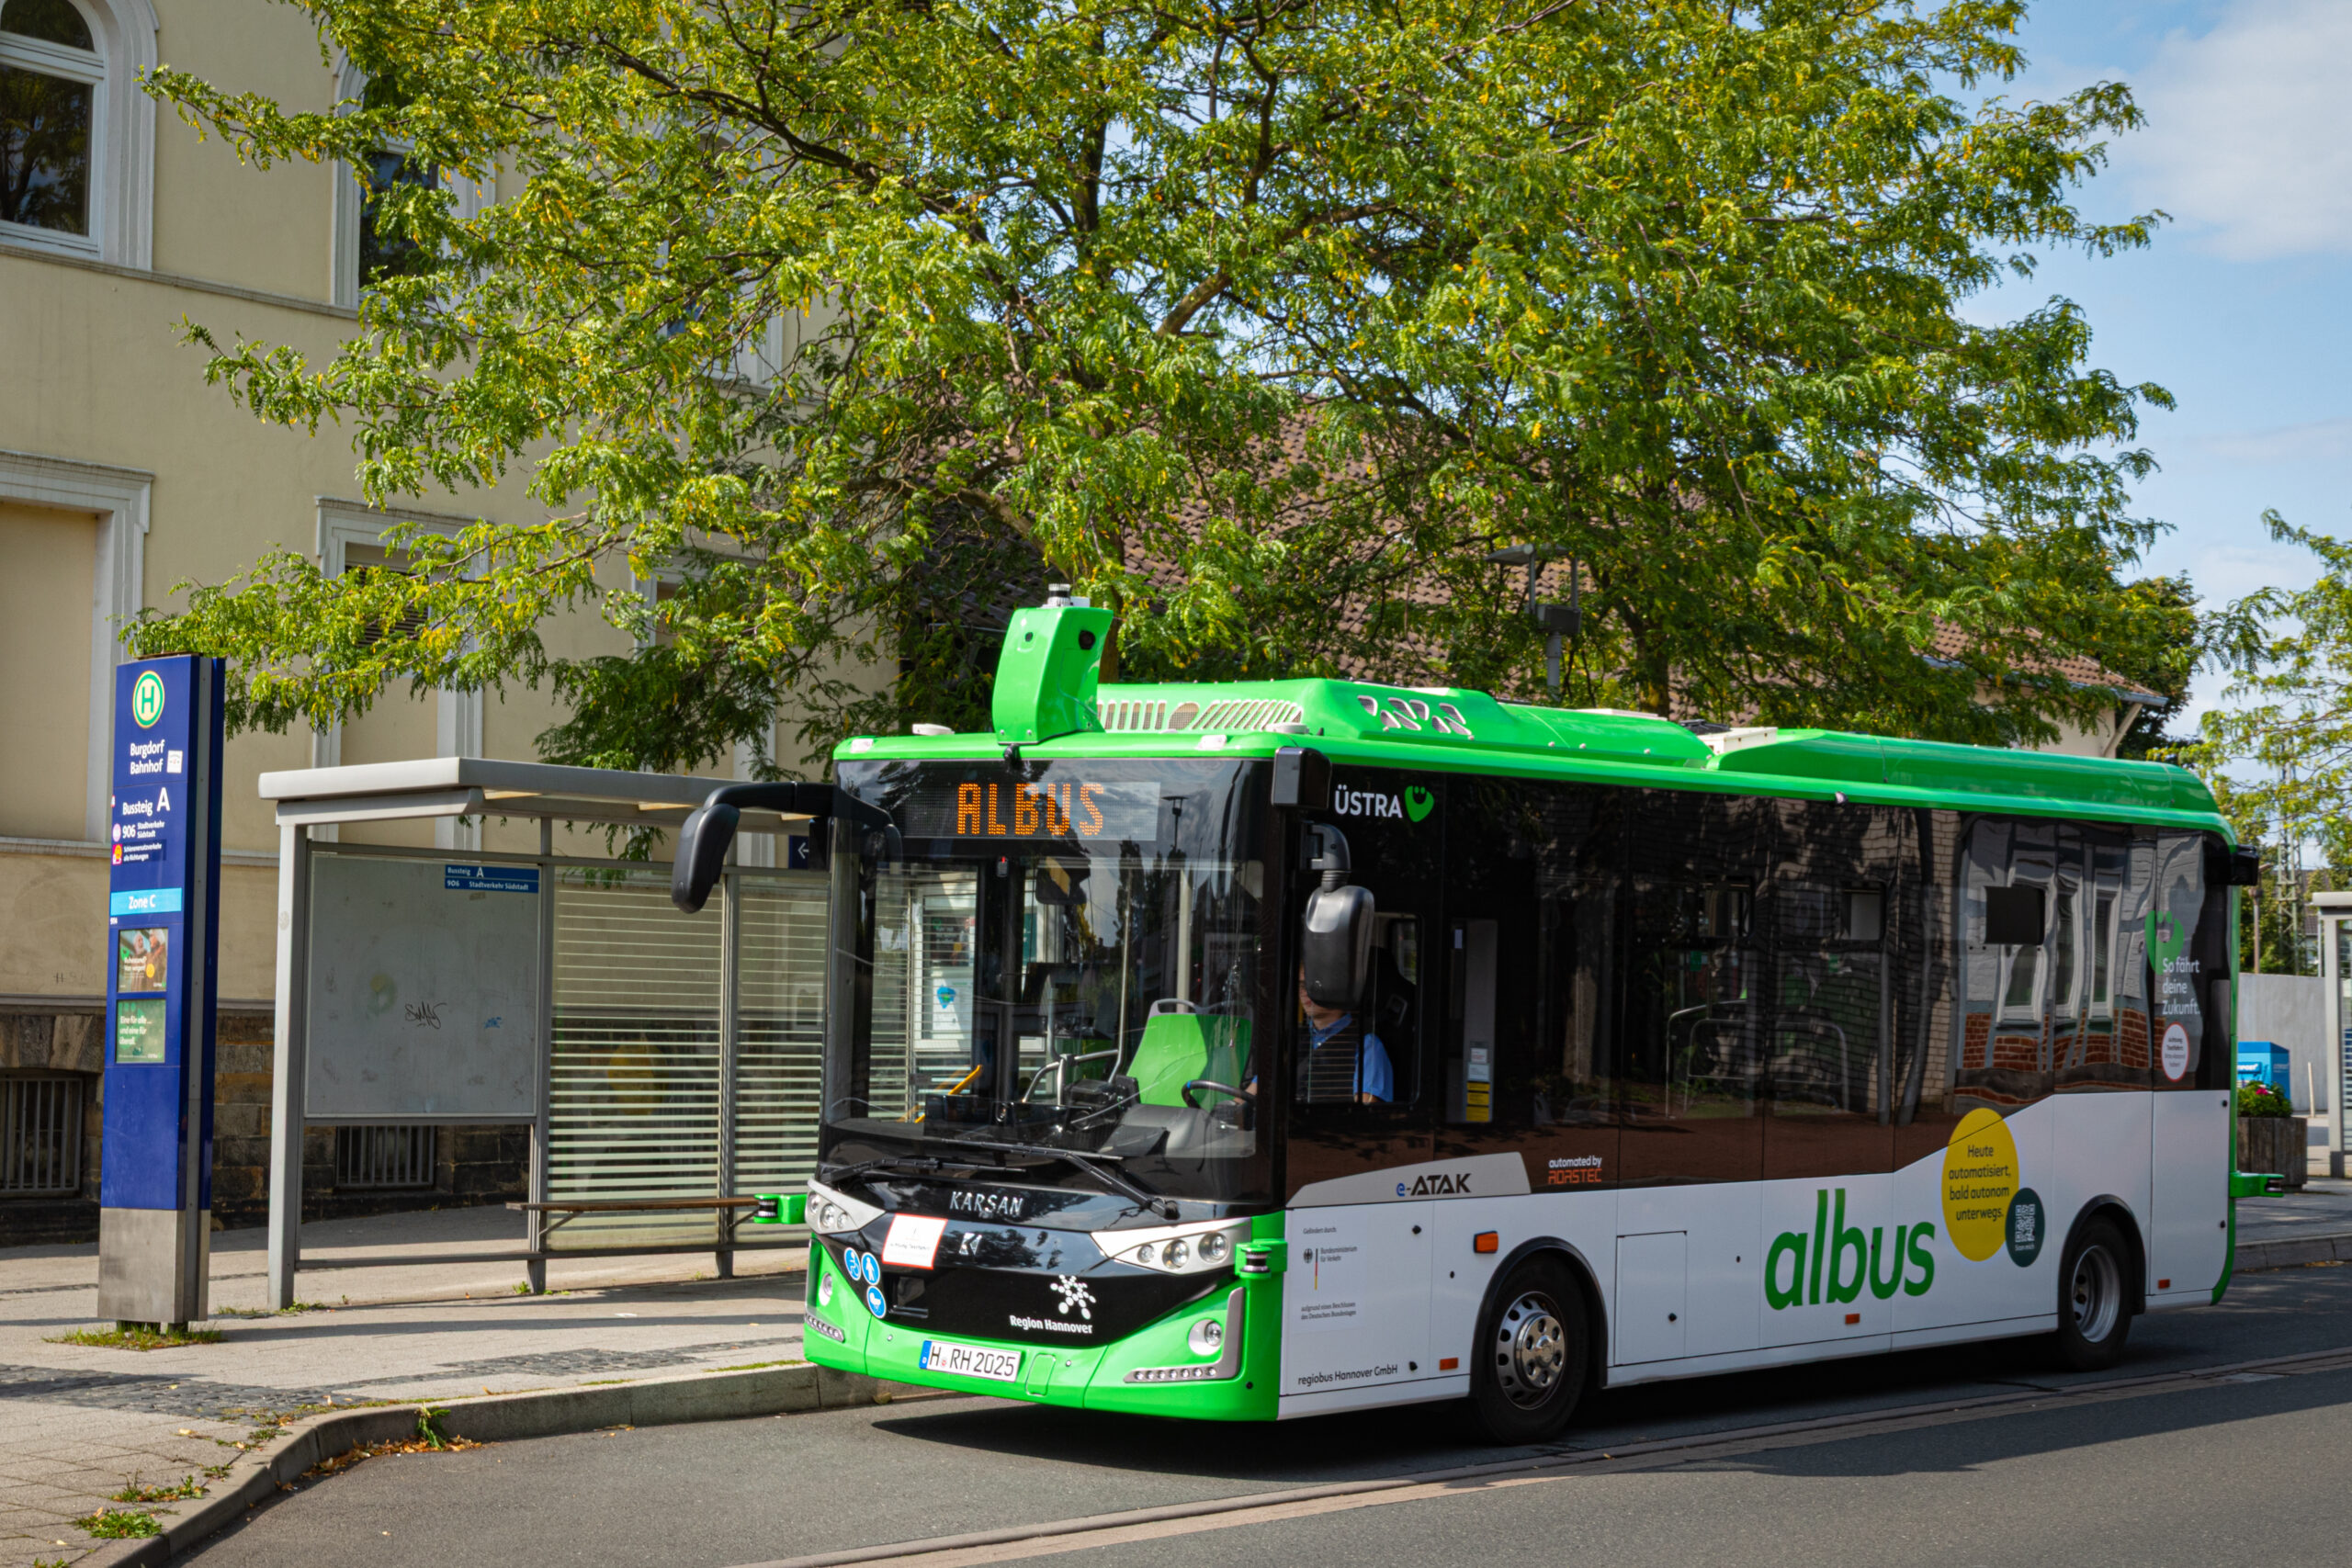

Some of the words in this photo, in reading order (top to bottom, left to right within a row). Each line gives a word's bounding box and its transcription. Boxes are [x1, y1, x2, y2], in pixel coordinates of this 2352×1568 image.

[141, 685, 155, 714] H
[130, 739, 165, 759] Burgdorf
[130, 758, 164, 775] Bahnhof
[122, 799, 153, 817] Bussteig
[156, 786, 171, 812] A
[956, 783, 1104, 836] ALBUS
[1334, 784, 1403, 818] ÜSTRA
[122, 824, 136, 839] 906
[137, 819, 165, 829] Stadtverkehr
[137, 830, 156, 839] Südstadt
[447, 866, 471, 876] Bussteig
[476, 866, 484, 878] A
[469, 881, 504, 889] Stadtverkehr
[504, 883, 529, 891] Südstadt
[129, 896, 150, 909] Zone
[149, 894, 156, 908] C
[2162, 957, 2175, 974] So
[2175, 956, 2200, 974] fährt
[2162, 977, 2188, 994] deine
[2162, 998, 2201, 1015] Zukunft.
[1967, 1145, 1995, 1157] Heute
[1548, 1156, 1591, 1168] automated
[1592, 1155, 1602, 1168] by
[1949, 1164, 2011, 1179] automatisiert,
[1396, 1172, 1473, 1197] e-ATAK
[1949, 1185, 1969, 1201] bald
[1971, 1186, 2010, 1199] autonom
[949, 1190, 1024, 1216] KARSAN
[1956, 1207, 2004, 1222] unterwegs.
[1764, 1187, 1936, 1311] albus
[1009, 1314, 1044, 1331] Region
[1045, 1319, 1093, 1335] Hannover
[929, 1345, 942, 1367] H
[949, 1348, 973, 1371] RH
[973, 1352, 1016, 1377] 2025
[1297, 1371, 1334, 1387] regiobus
[1334, 1368, 1373, 1382] Hannover
[1374, 1364, 1398, 1376] GmbH
